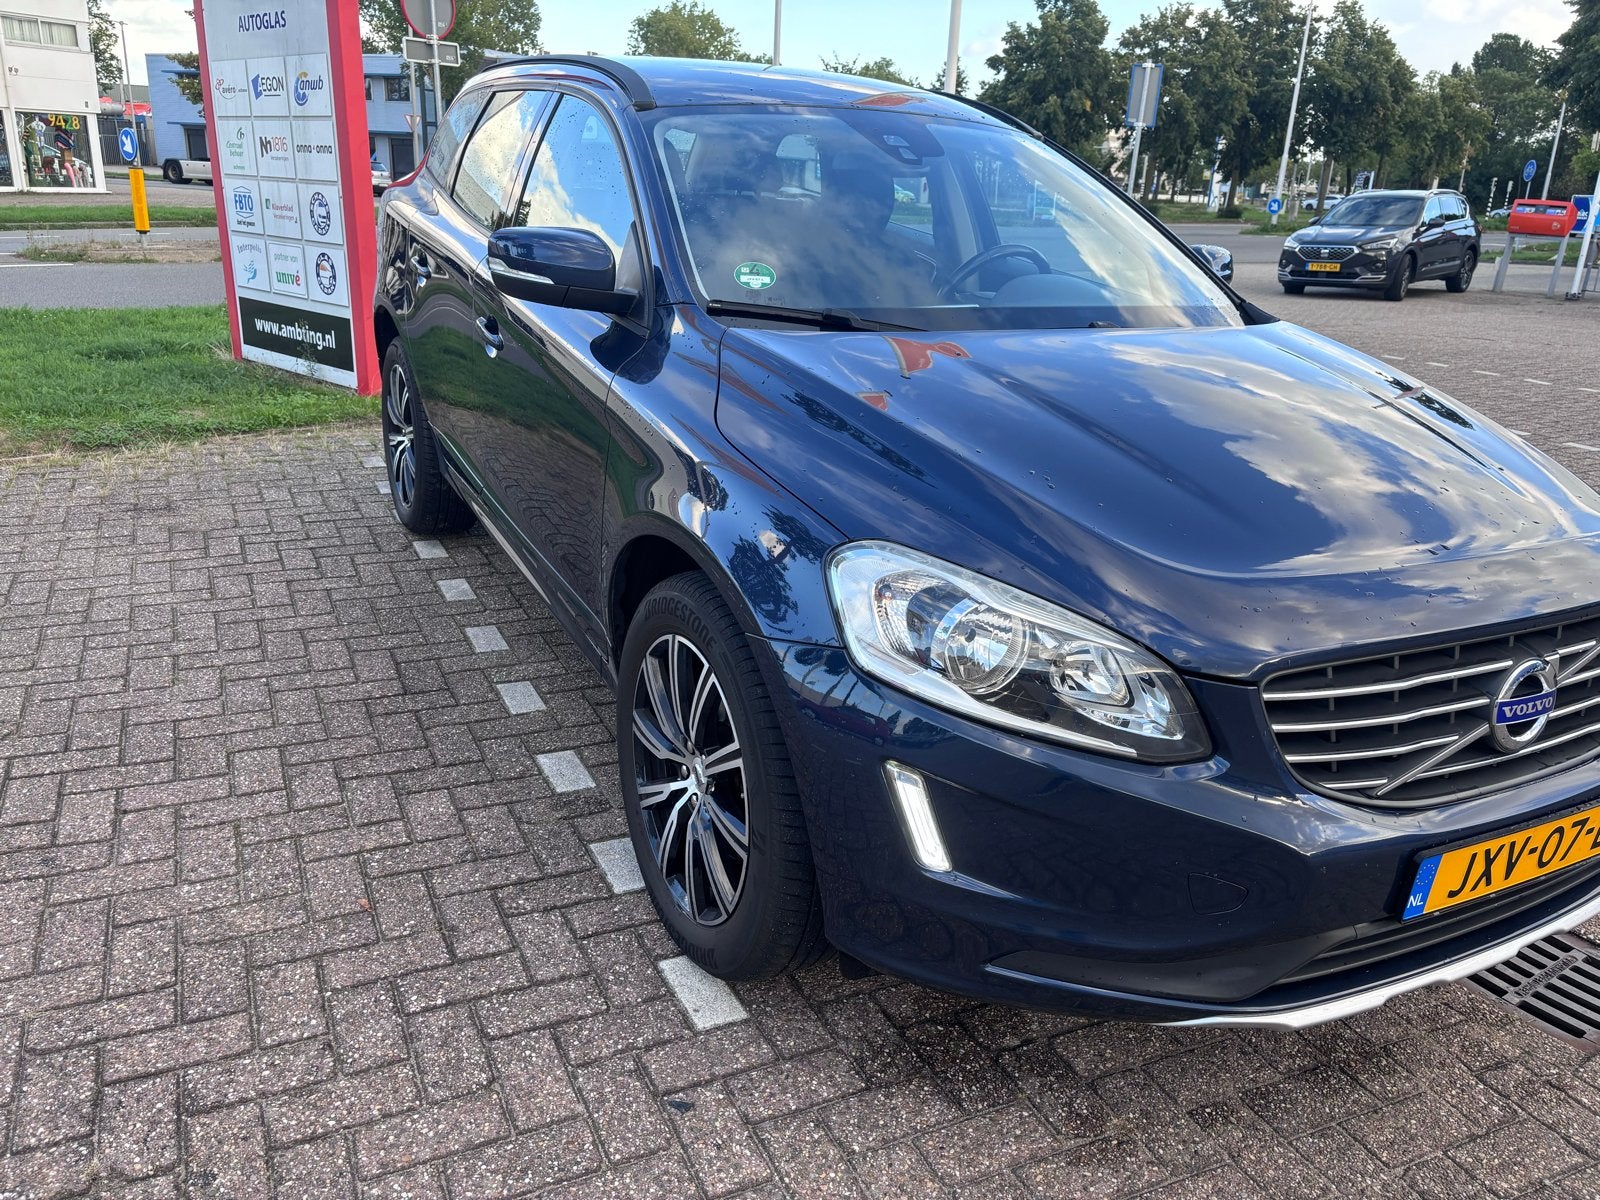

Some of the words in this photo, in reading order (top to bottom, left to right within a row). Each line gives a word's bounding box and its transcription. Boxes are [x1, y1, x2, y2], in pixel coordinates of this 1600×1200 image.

[238, 10, 287, 32] AUTOGLAS
[299, 74, 324, 91] anwb
[47, 112, 80, 130] 9428
[234, 193, 254, 211] FBTO
[276, 270, 301, 287] univé
[254, 318, 336, 350] www.ambting.nl
[643, 595, 718, 654] BRIDGESTONE
[1502, 697, 1554, 718] VOLVO
[1407, 893, 1425, 909] NL
